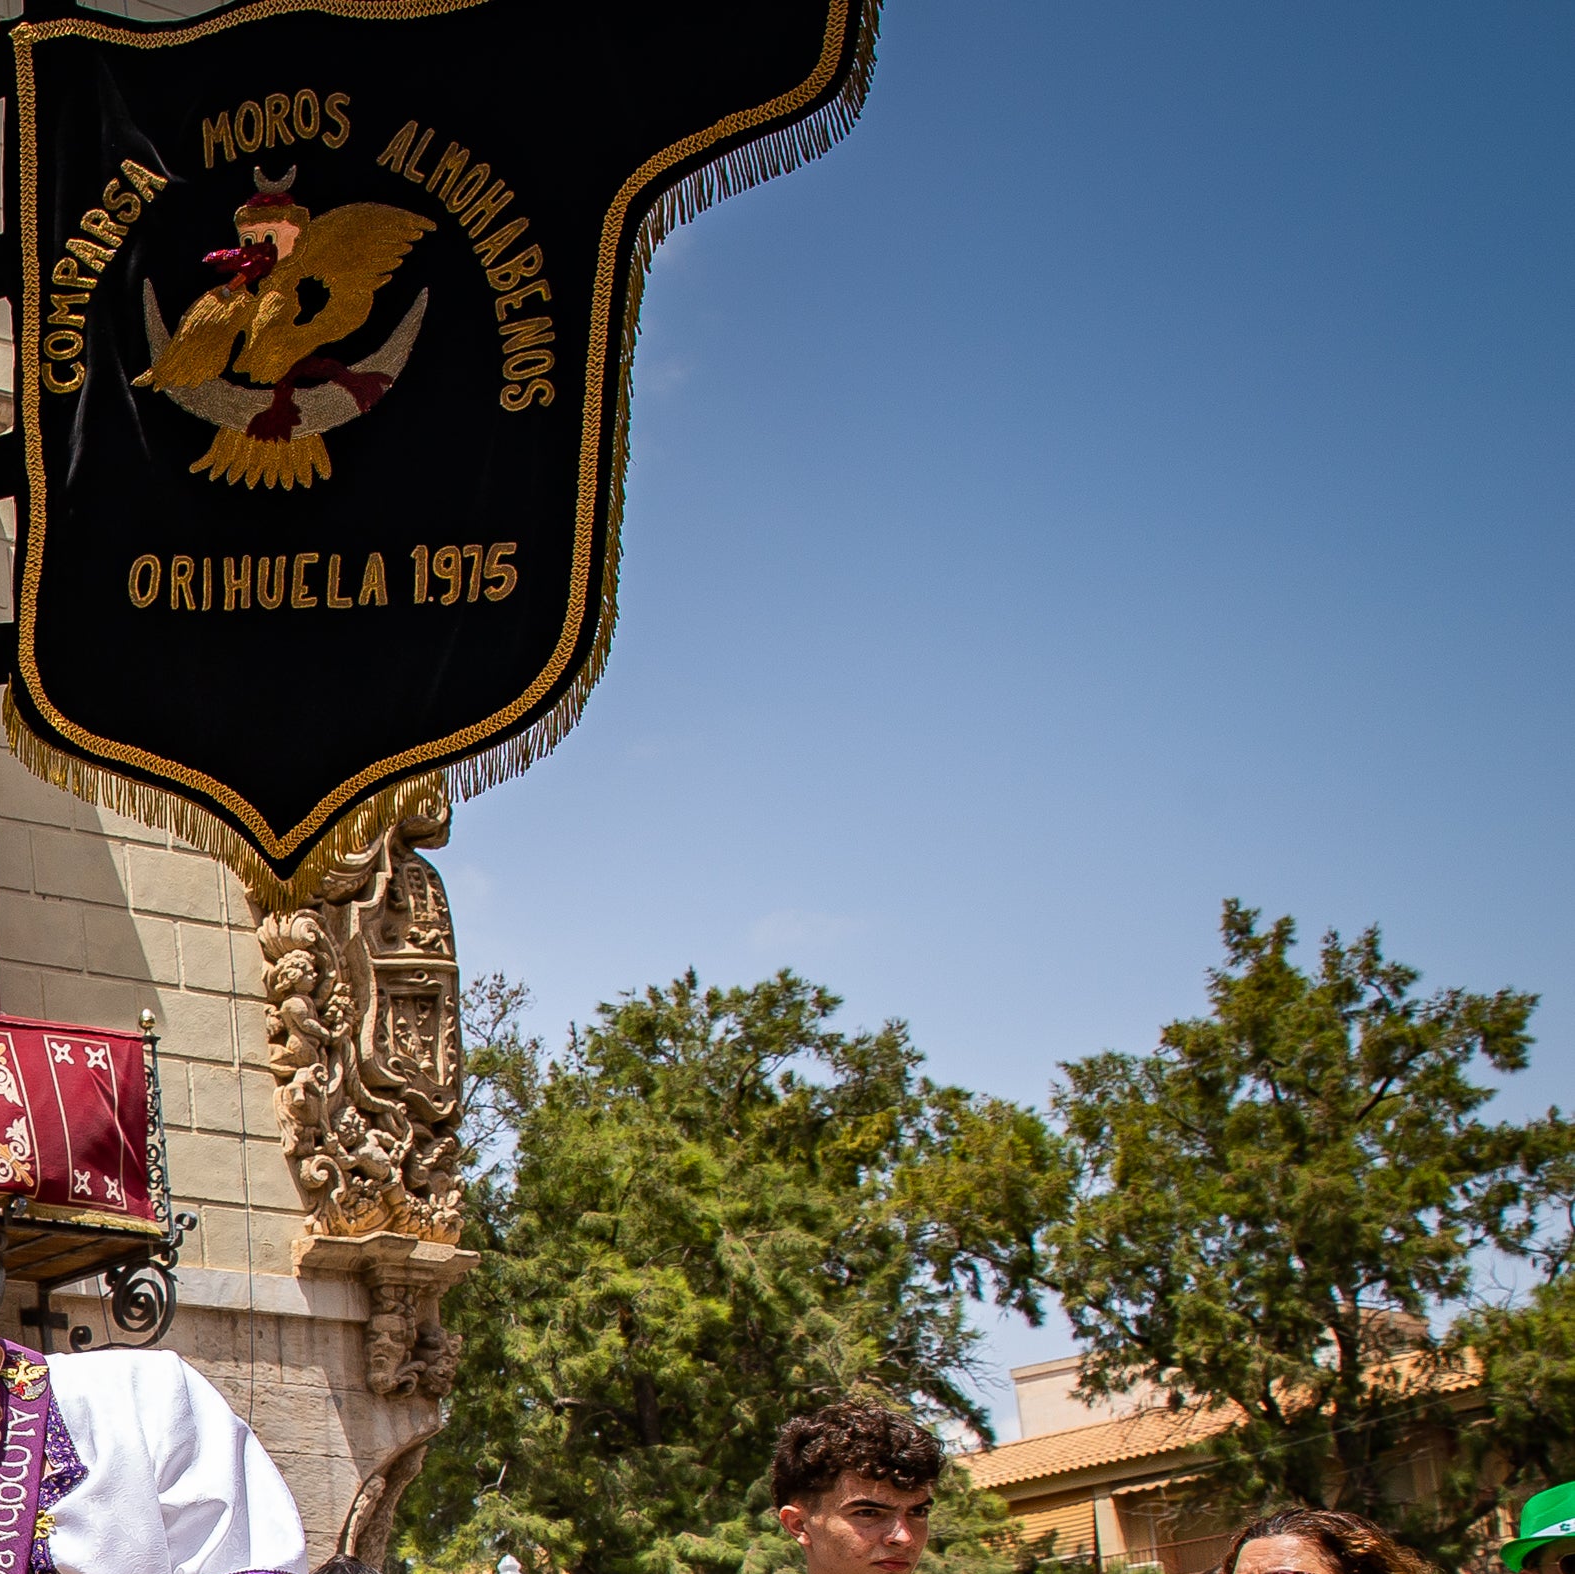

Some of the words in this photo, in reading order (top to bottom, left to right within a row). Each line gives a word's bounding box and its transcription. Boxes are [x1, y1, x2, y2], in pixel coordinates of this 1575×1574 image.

[42, 157, 168, 394] COMPARSA
[202, 88, 351, 168] MOROS
[378, 119, 555, 411] ALMOHABENOS
[128, 553, 388, 611] ORIHUELA
